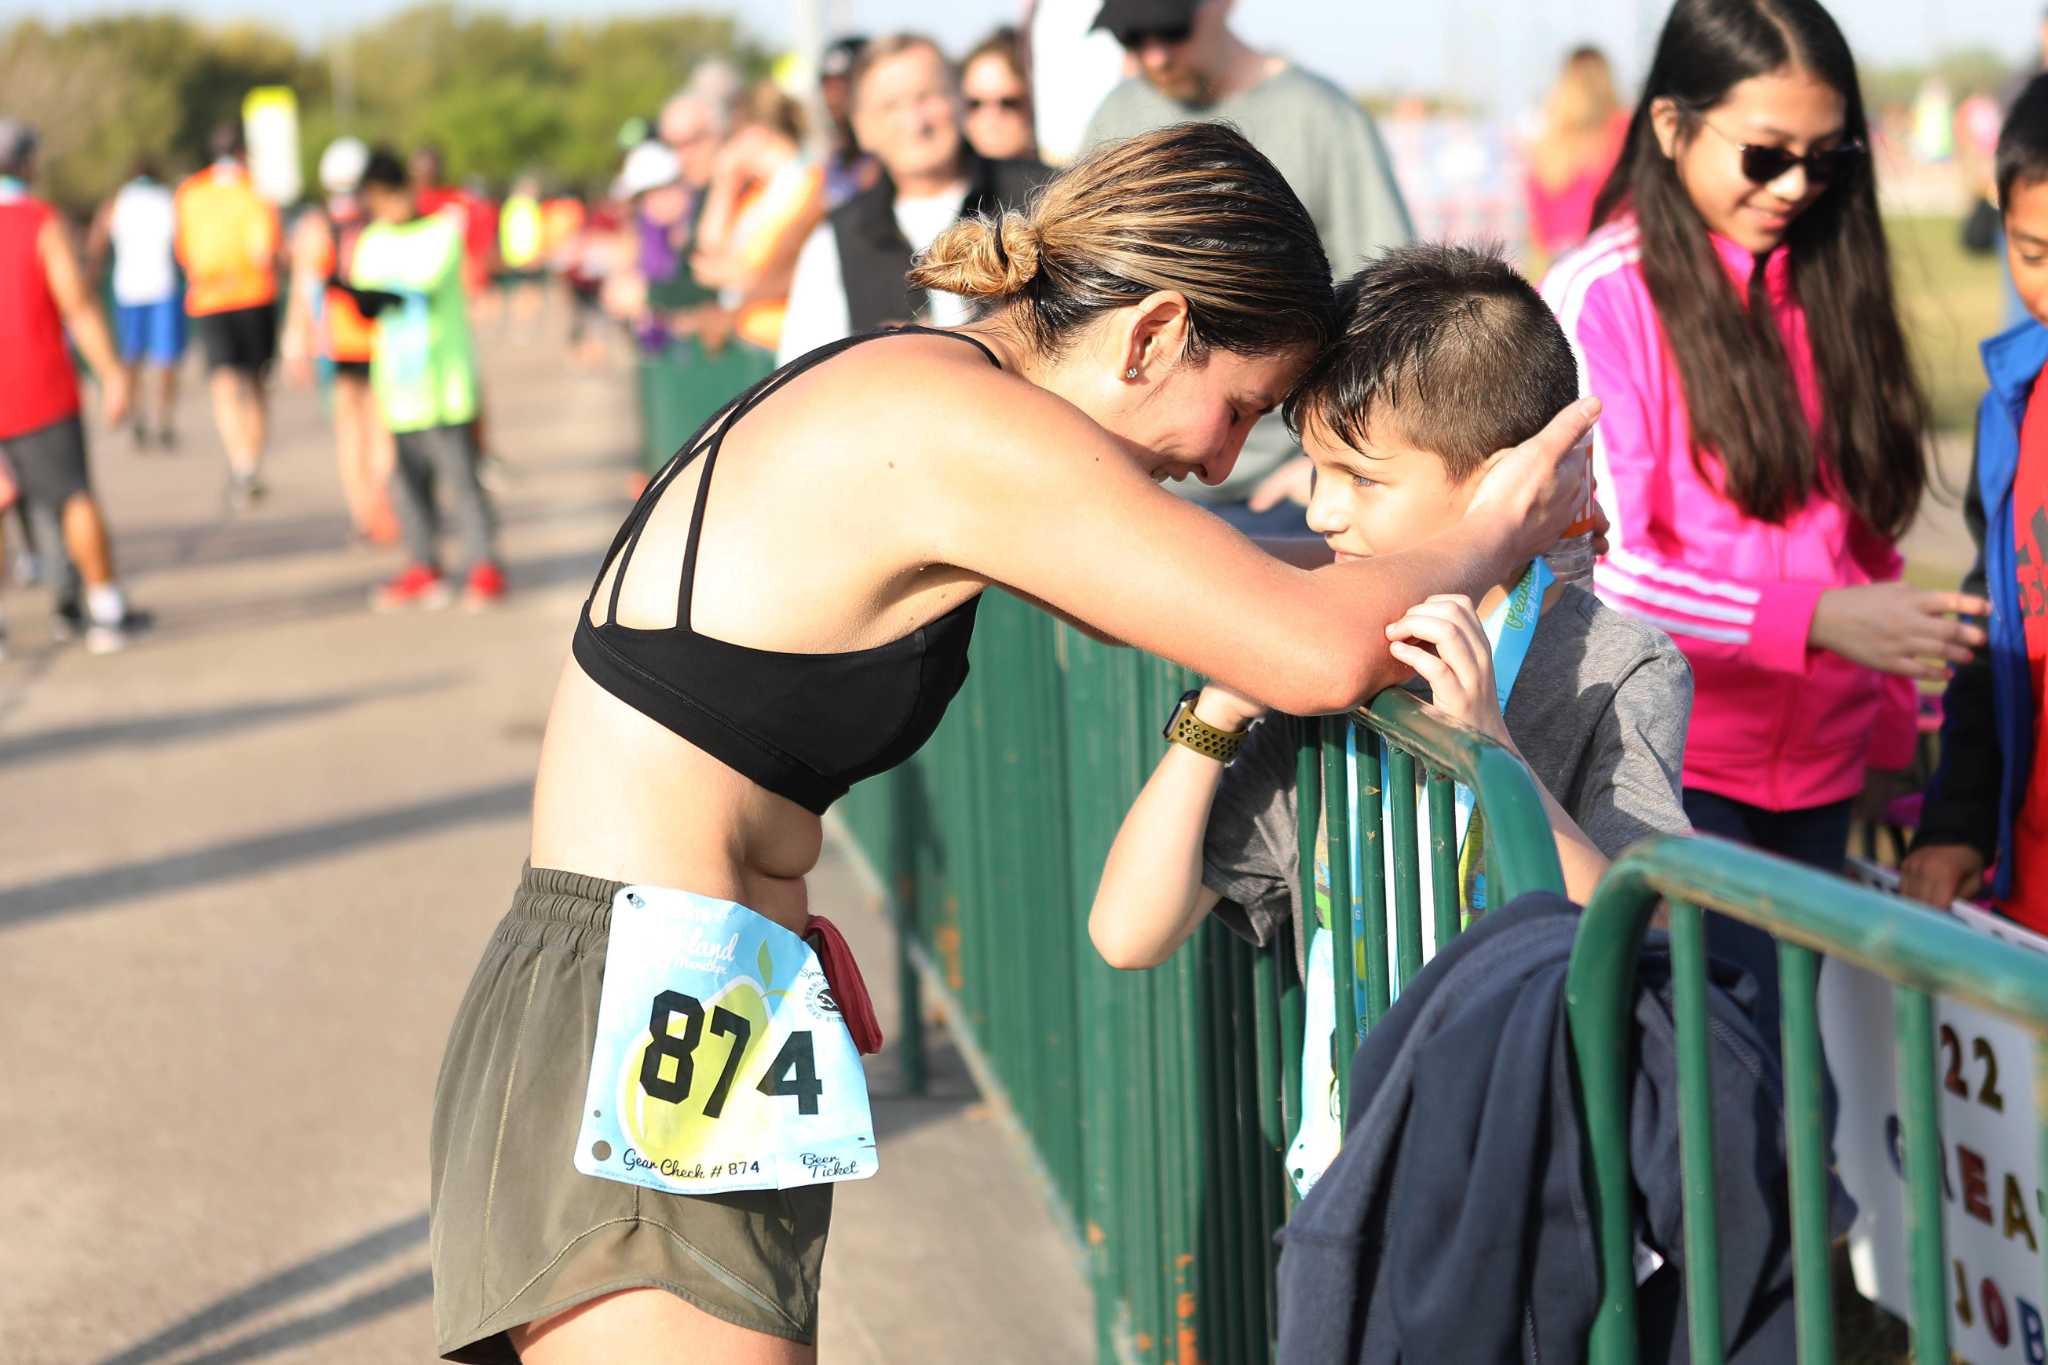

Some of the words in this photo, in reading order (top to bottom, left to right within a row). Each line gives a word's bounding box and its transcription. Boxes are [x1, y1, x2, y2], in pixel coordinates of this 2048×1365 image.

[639, 989, 823, 1119] 874
[622, 1147, 658, 1171] Gear
[660, 1158, 705, 1179] Check
[710, 1164, 723, 1178] #
[728, 1160, 760, 1176] 874
[799, 1152, 840, 1166] Beer
[807, 1160, 859, 1179] Ticket
